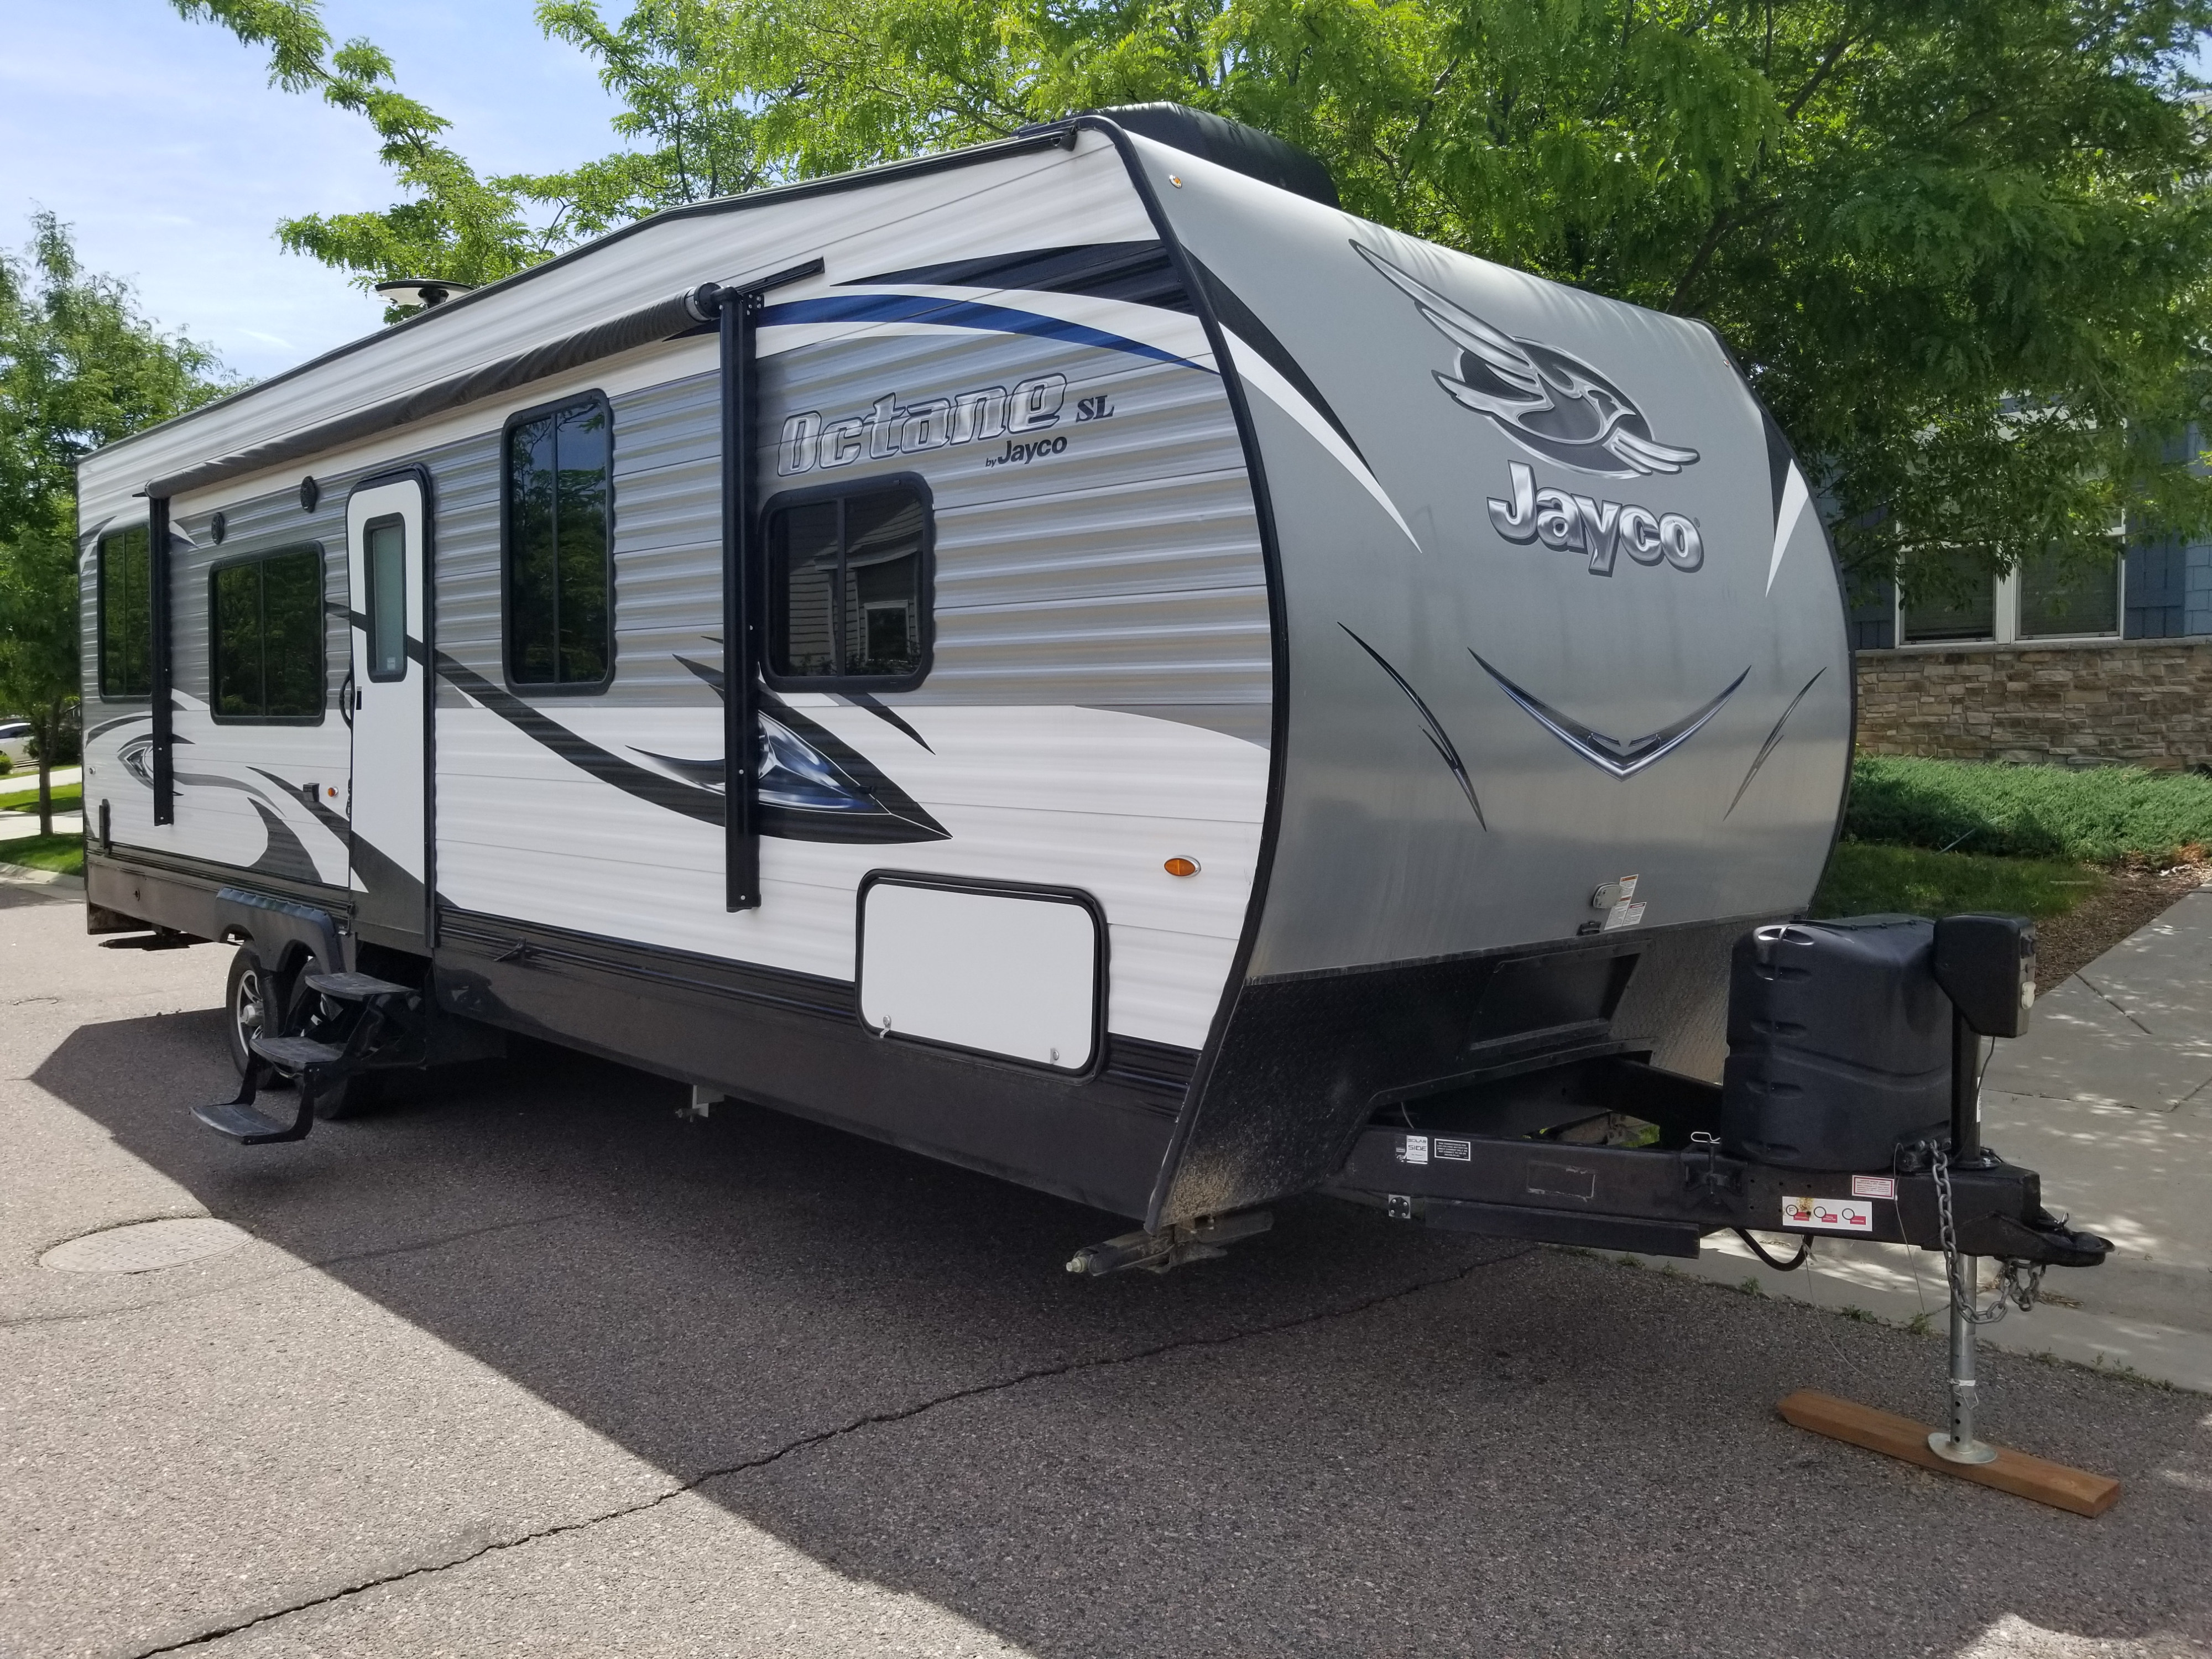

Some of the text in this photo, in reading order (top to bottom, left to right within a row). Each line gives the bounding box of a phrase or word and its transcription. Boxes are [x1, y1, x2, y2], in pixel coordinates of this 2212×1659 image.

[778, 373, 1115, 477] Octane SL
[985, 436, 1068, 468] by Jayco
[1486, 460, 1704, 577] Jayco
